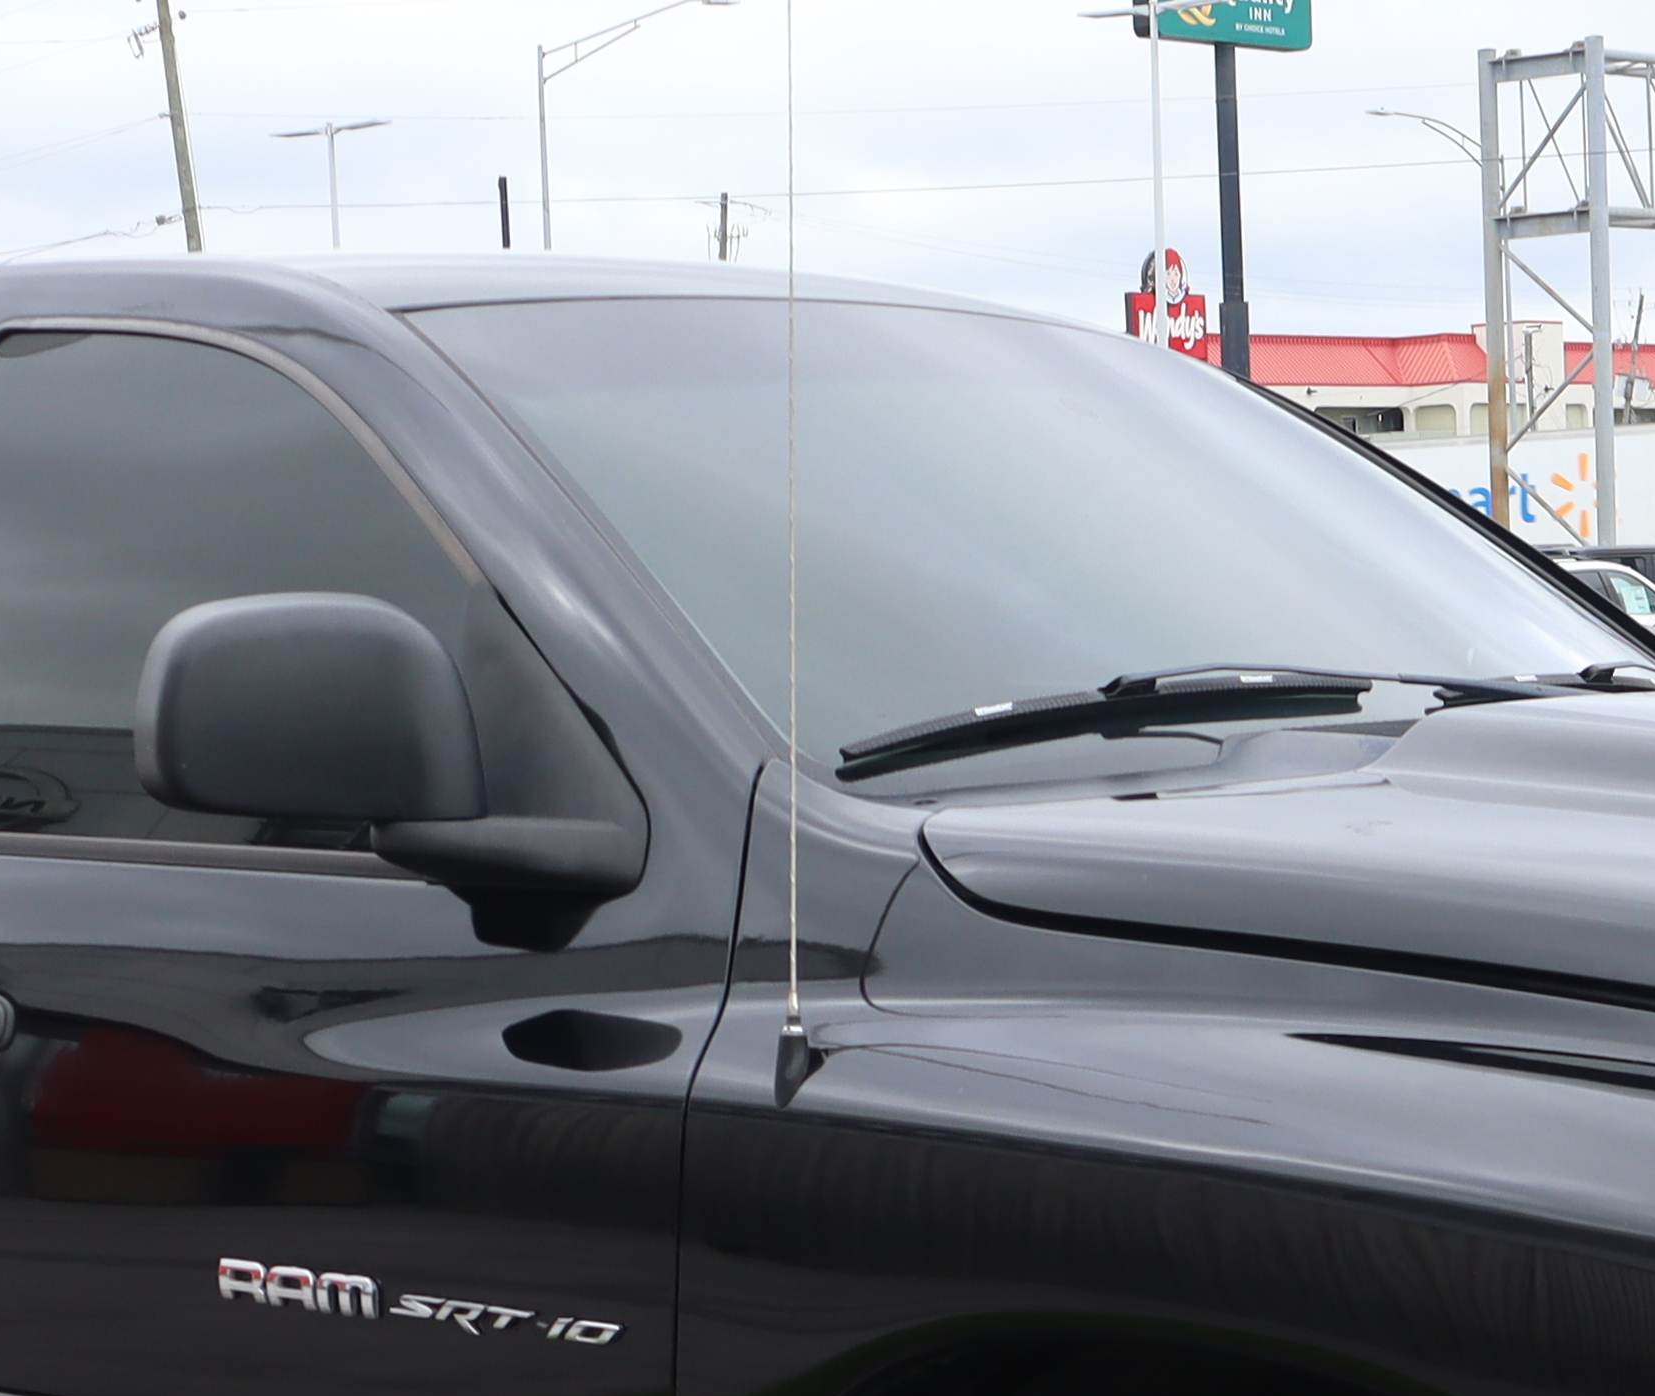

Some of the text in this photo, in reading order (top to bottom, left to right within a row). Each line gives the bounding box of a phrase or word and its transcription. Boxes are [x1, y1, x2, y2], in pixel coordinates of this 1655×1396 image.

[1249, 6, 1271, 21] INN
[1138, 302, 1204, 350] Wndy's
[218, 1257, 625, 1345] RAM SRT-10
